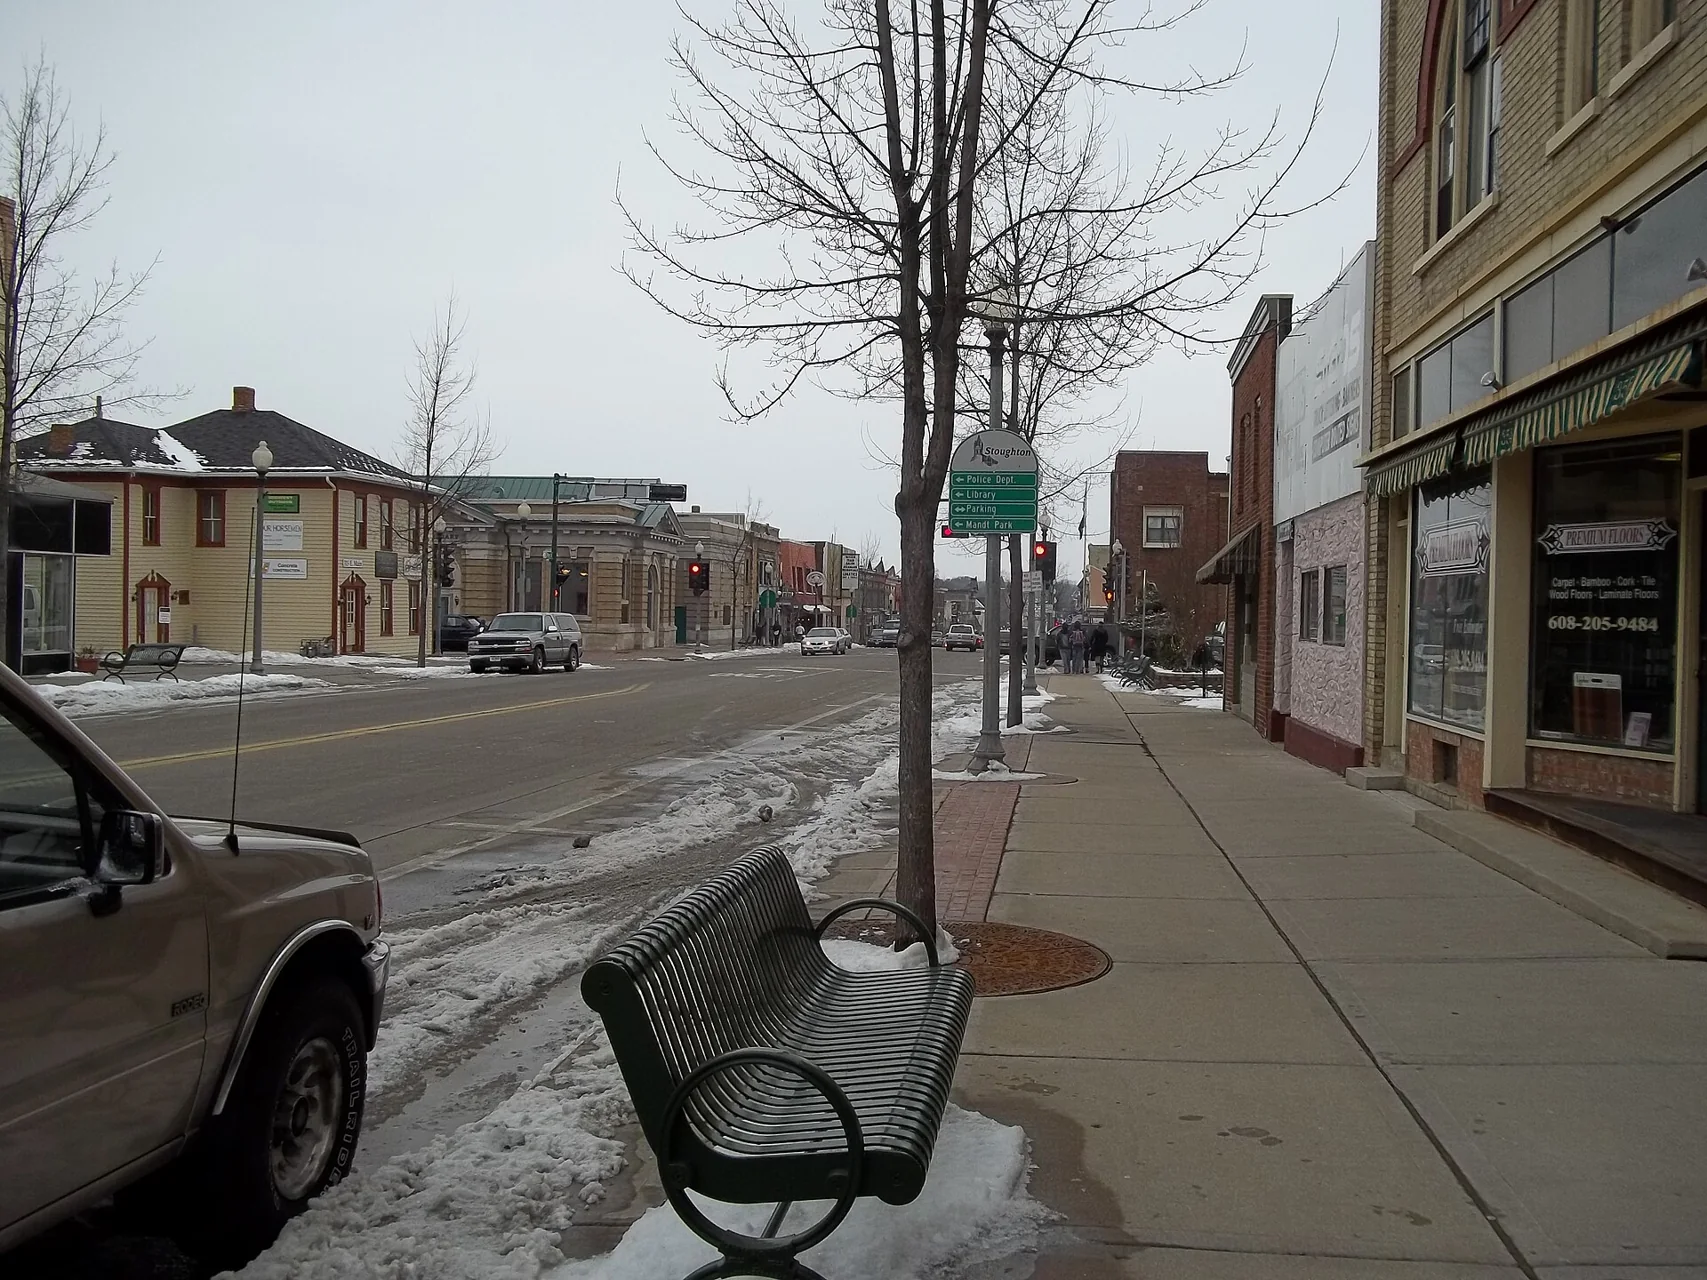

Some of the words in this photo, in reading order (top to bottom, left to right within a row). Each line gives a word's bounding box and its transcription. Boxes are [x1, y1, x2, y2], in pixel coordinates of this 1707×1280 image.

[985, 447, 1031, 458] Stoughton
[967, 475, 992, 483] Police
[996, 475, 1016, 485] Dept.
[967, 490, 996, 499] Library
[966, 504, 997, 515] Parking
[1566, 530, 1607, 546] PREMIUM
[1609, 527, 1645, 544] FLOORS
[1552, 577, 1575, 588] Carpet
[1581, 577, 1611, 587] Bamboo
[1617, 576, 1635, 586] Cork
[1641, 575, 1656, 586] Tile
[1549, 589, 1569, 599] Wood
[1570, 589, 1593, 599] Floors
[1598, 589, 1633, 599] Laminate
[1634, 588, 1659, 599] Floors
[1548, 615, 1659, 631] 608-205-9484
[171, 992, 205, 1017] RODEO
[341, 1026, 361, 1108] TRAIL
